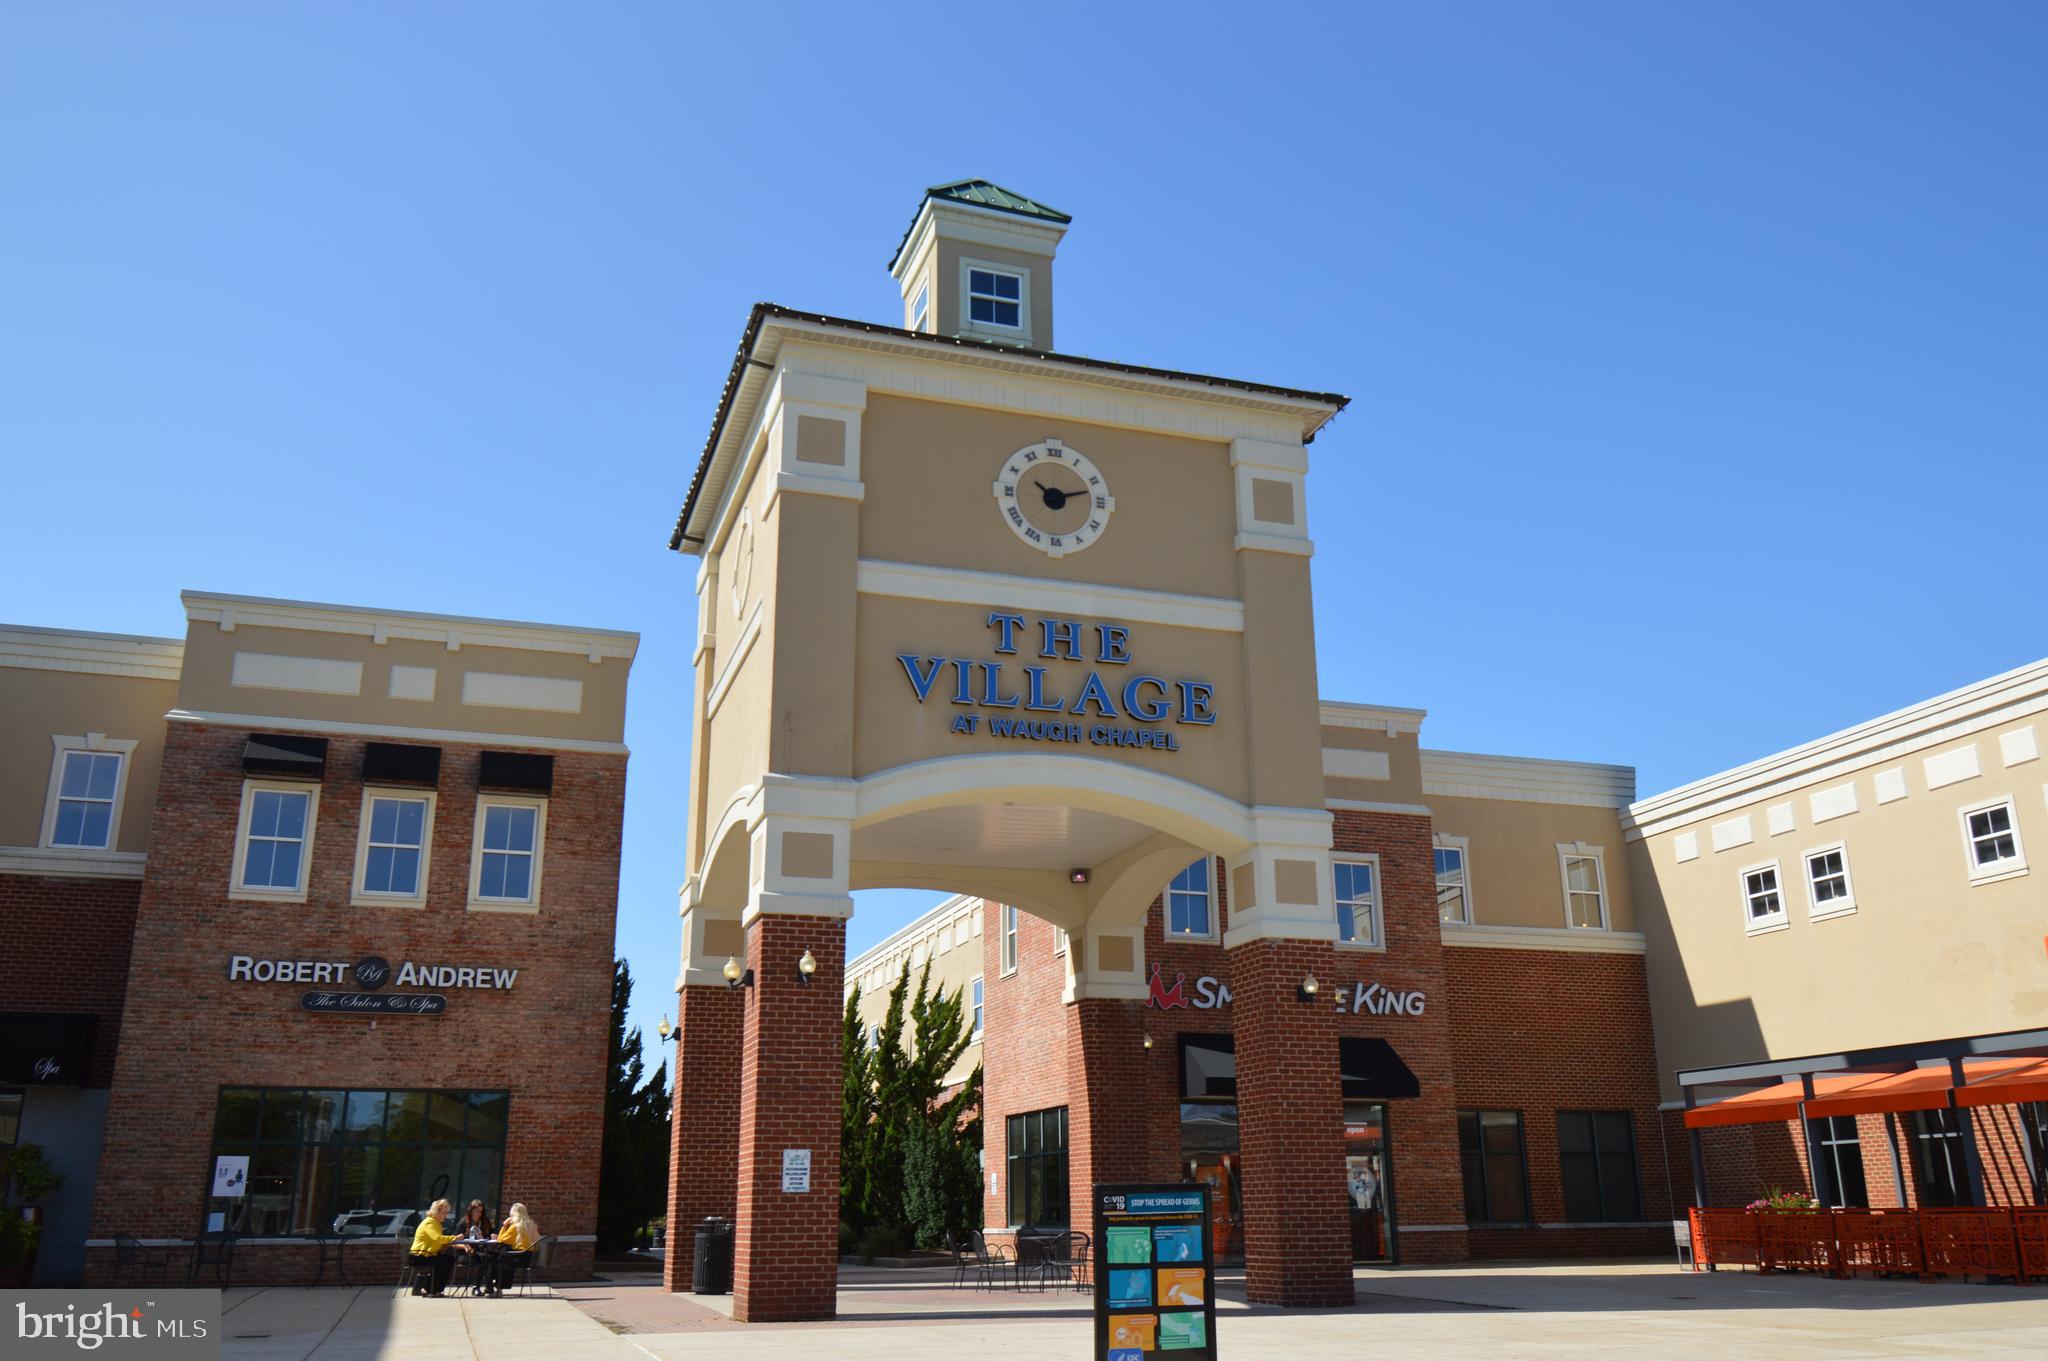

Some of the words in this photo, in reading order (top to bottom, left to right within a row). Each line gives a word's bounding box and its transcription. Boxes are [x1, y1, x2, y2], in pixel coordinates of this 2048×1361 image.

[1024, 451, 1038, 462] XI
[1046, 448, 1062, 458] XII
[986, 611, 1133, 665] THE
[896, 652, 1218, 726] VILLAGE
[950, 713, 983, 735] AT
[989, 717, 1084, 743] WAUGH
[1090, 724, 1181, 751] CHAPEL
[229, 955, 351, 984] ROBERT
[395, 961, 519, 990] ANDREW
[308, 993, 337, 1008] The
[340, 994, 382, 1009] Salon
[409, 995, 439, 1014] Spa
[1116, 1202, 1126, 1210] 19
[1131, 1199, 1144, 1207] STOP
[1155, 1198, 1175, 1206] SPREAD
[1175, 1198, 1182, 1206] OF
[1182, 1197, 1200, 1206] GERMS
